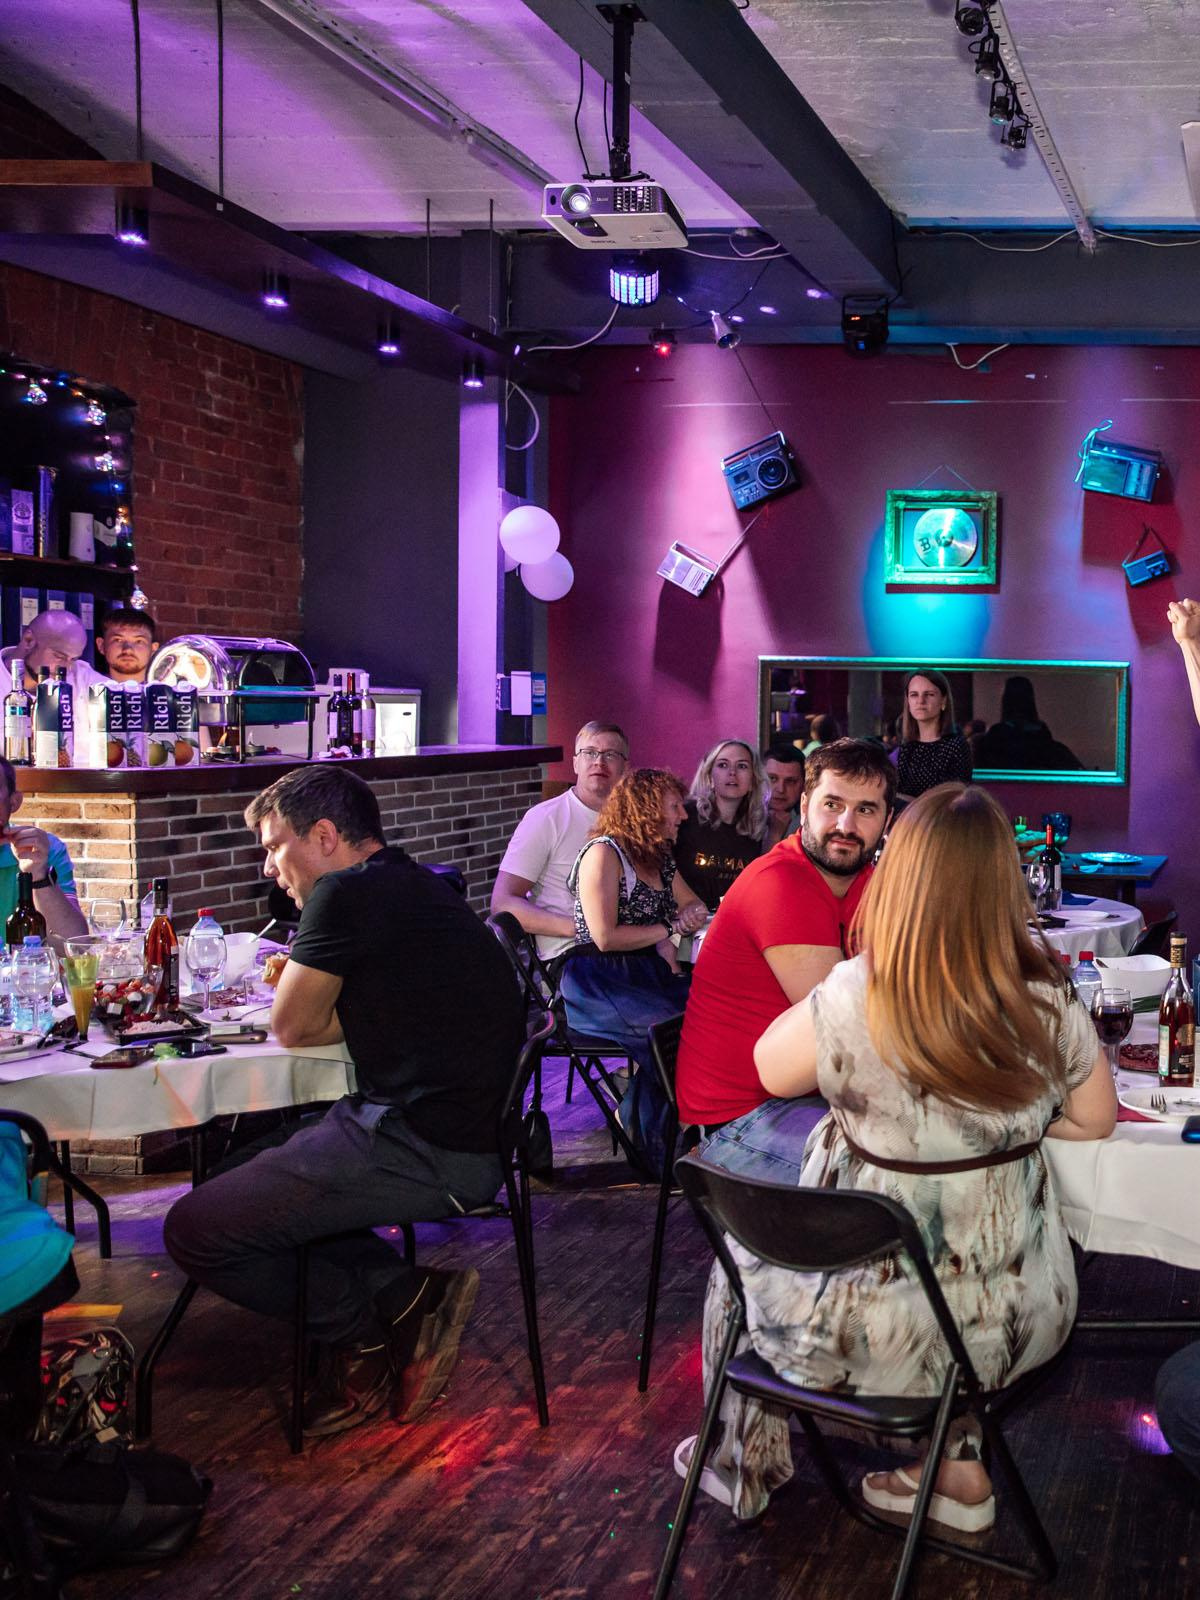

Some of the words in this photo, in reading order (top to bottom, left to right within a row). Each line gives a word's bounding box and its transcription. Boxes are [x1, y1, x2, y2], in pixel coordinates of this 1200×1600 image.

[60, 694, 72, 729] Rich
[110, 694, 123, 730] Rich
[127, 694, 142, 729] Rich
[153, 695, 169, 730] Rich
[176, 695, 192, 729] Rich
